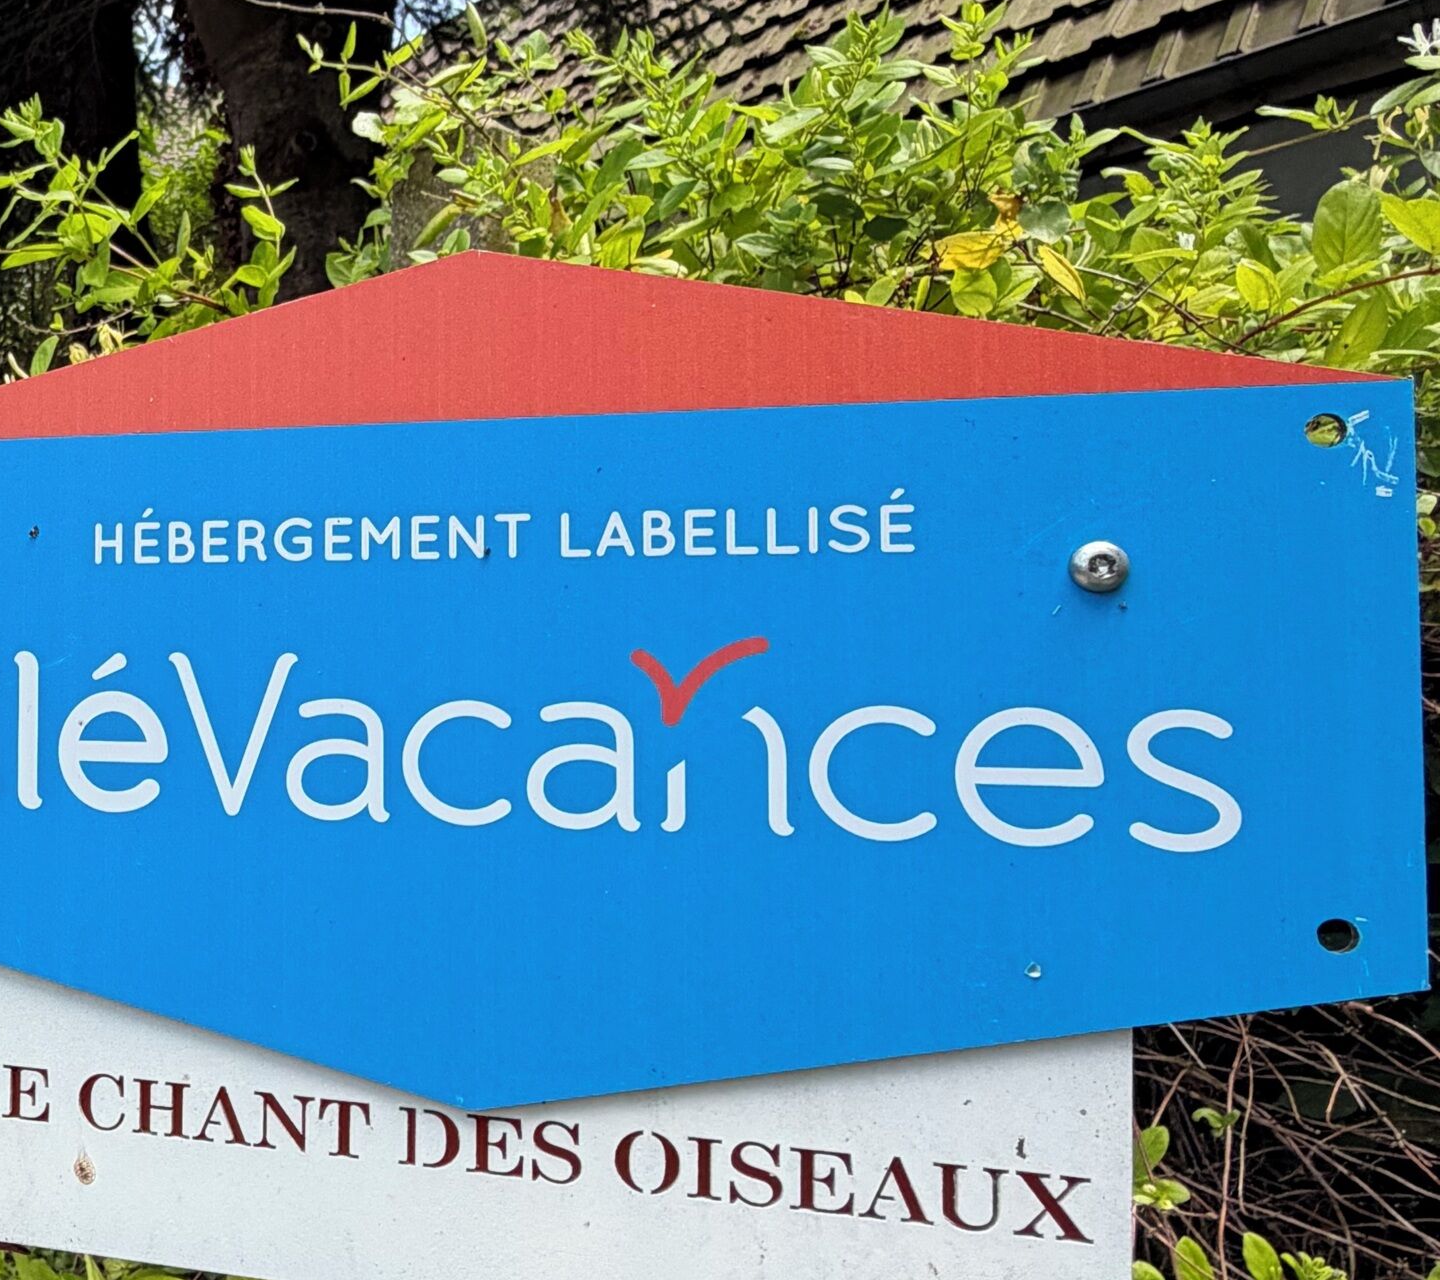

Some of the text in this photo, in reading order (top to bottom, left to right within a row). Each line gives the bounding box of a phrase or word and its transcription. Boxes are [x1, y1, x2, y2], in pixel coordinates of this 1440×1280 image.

[94, 487, 916, 565] HÉBERGEMENT LABELLISÉ
[77, 1073, 371, 1159] CHANT
[397, 1106, 583, 1185] DES
[613, 1129, 1095, 1244] OISEAUX
